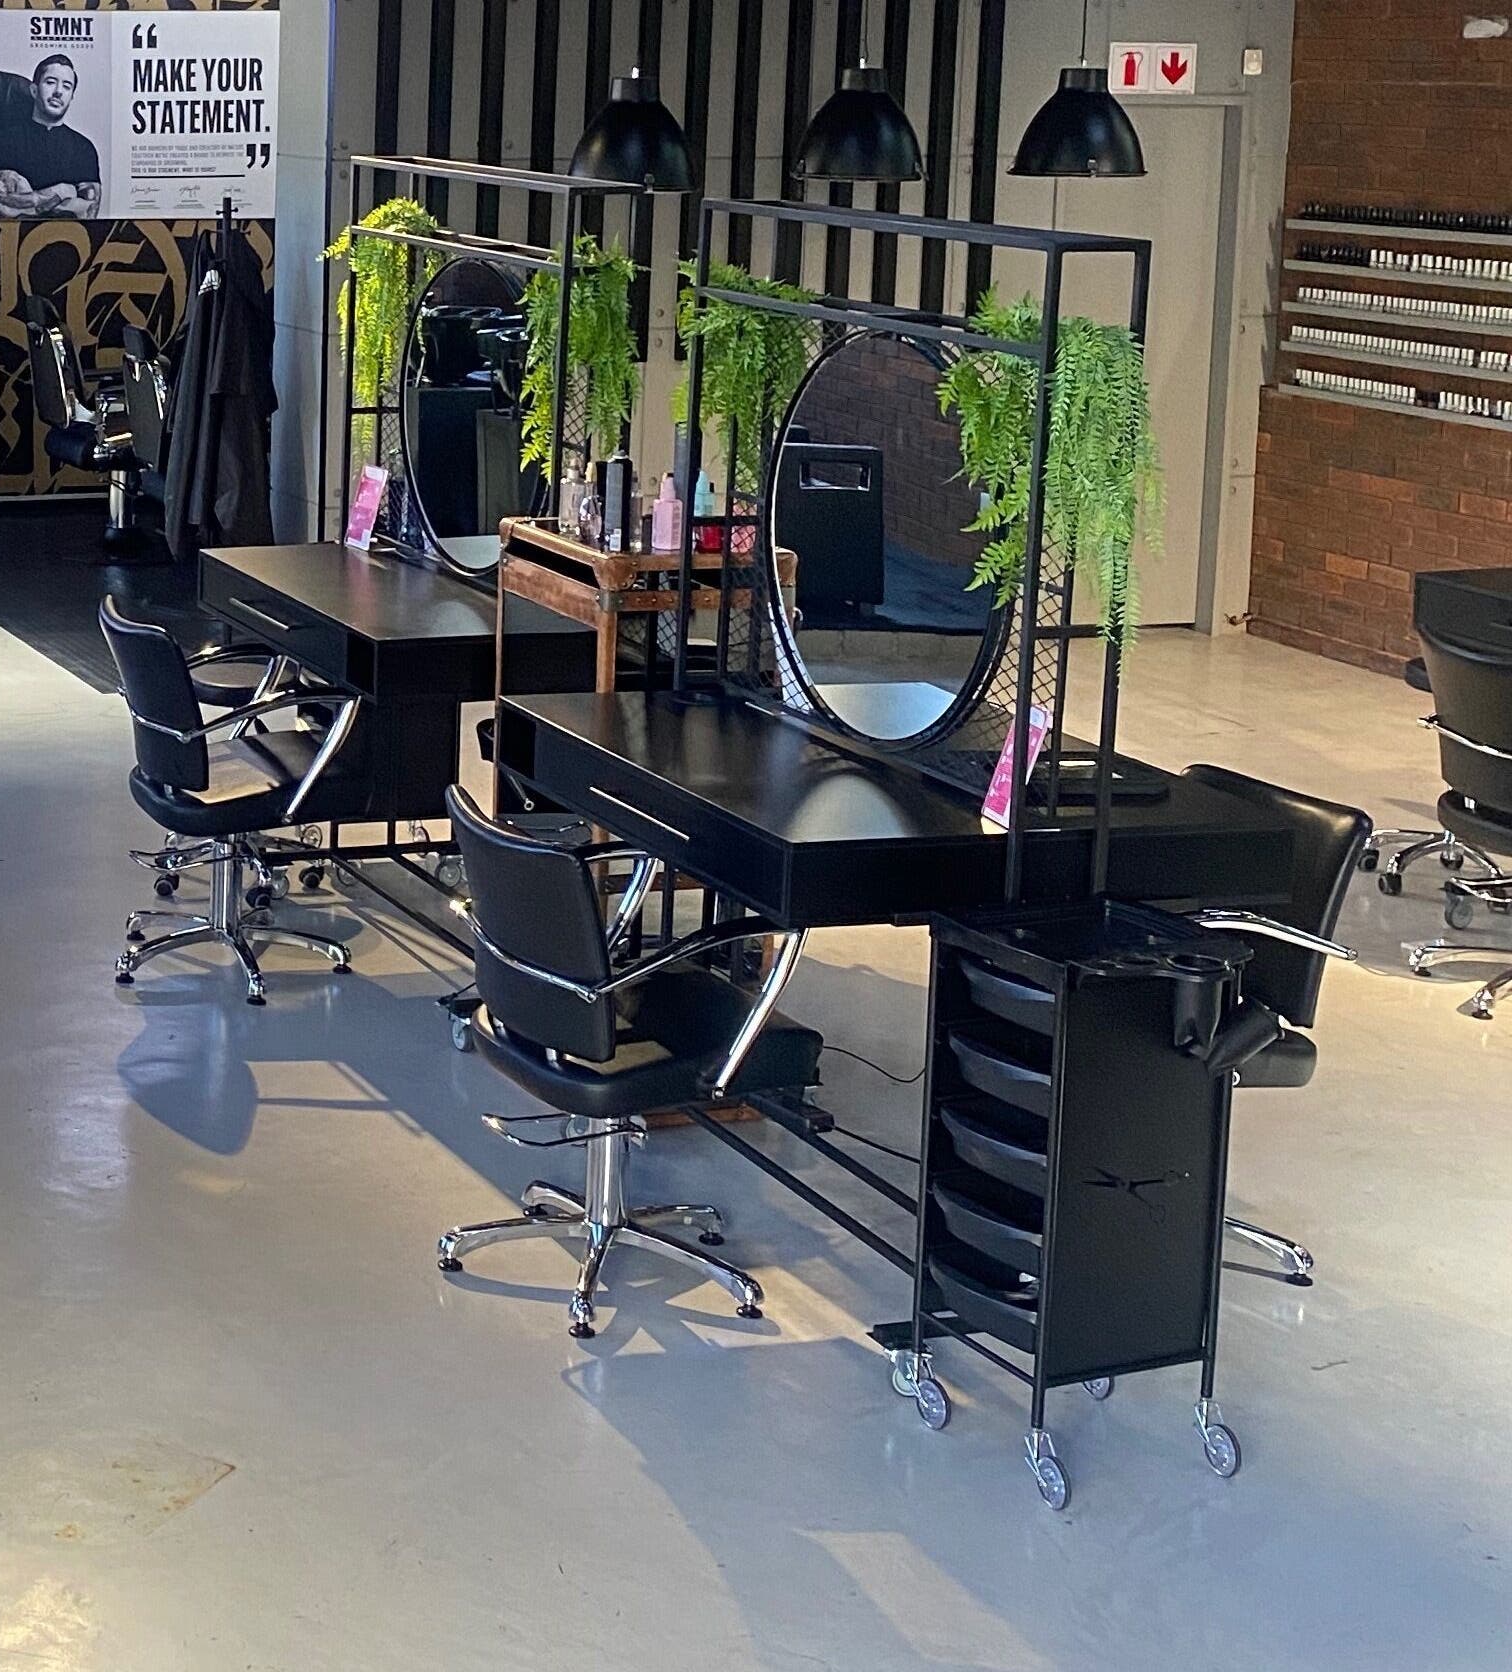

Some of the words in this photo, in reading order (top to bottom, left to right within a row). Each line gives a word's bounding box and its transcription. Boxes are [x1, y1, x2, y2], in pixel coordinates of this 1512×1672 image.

[30, 16, 94, 35] STMNT
[133, 58, 197, 92] MAKE
[202, 57, 263, 92] YOUR
[132, 99, 271, 134] STATEMENT.
